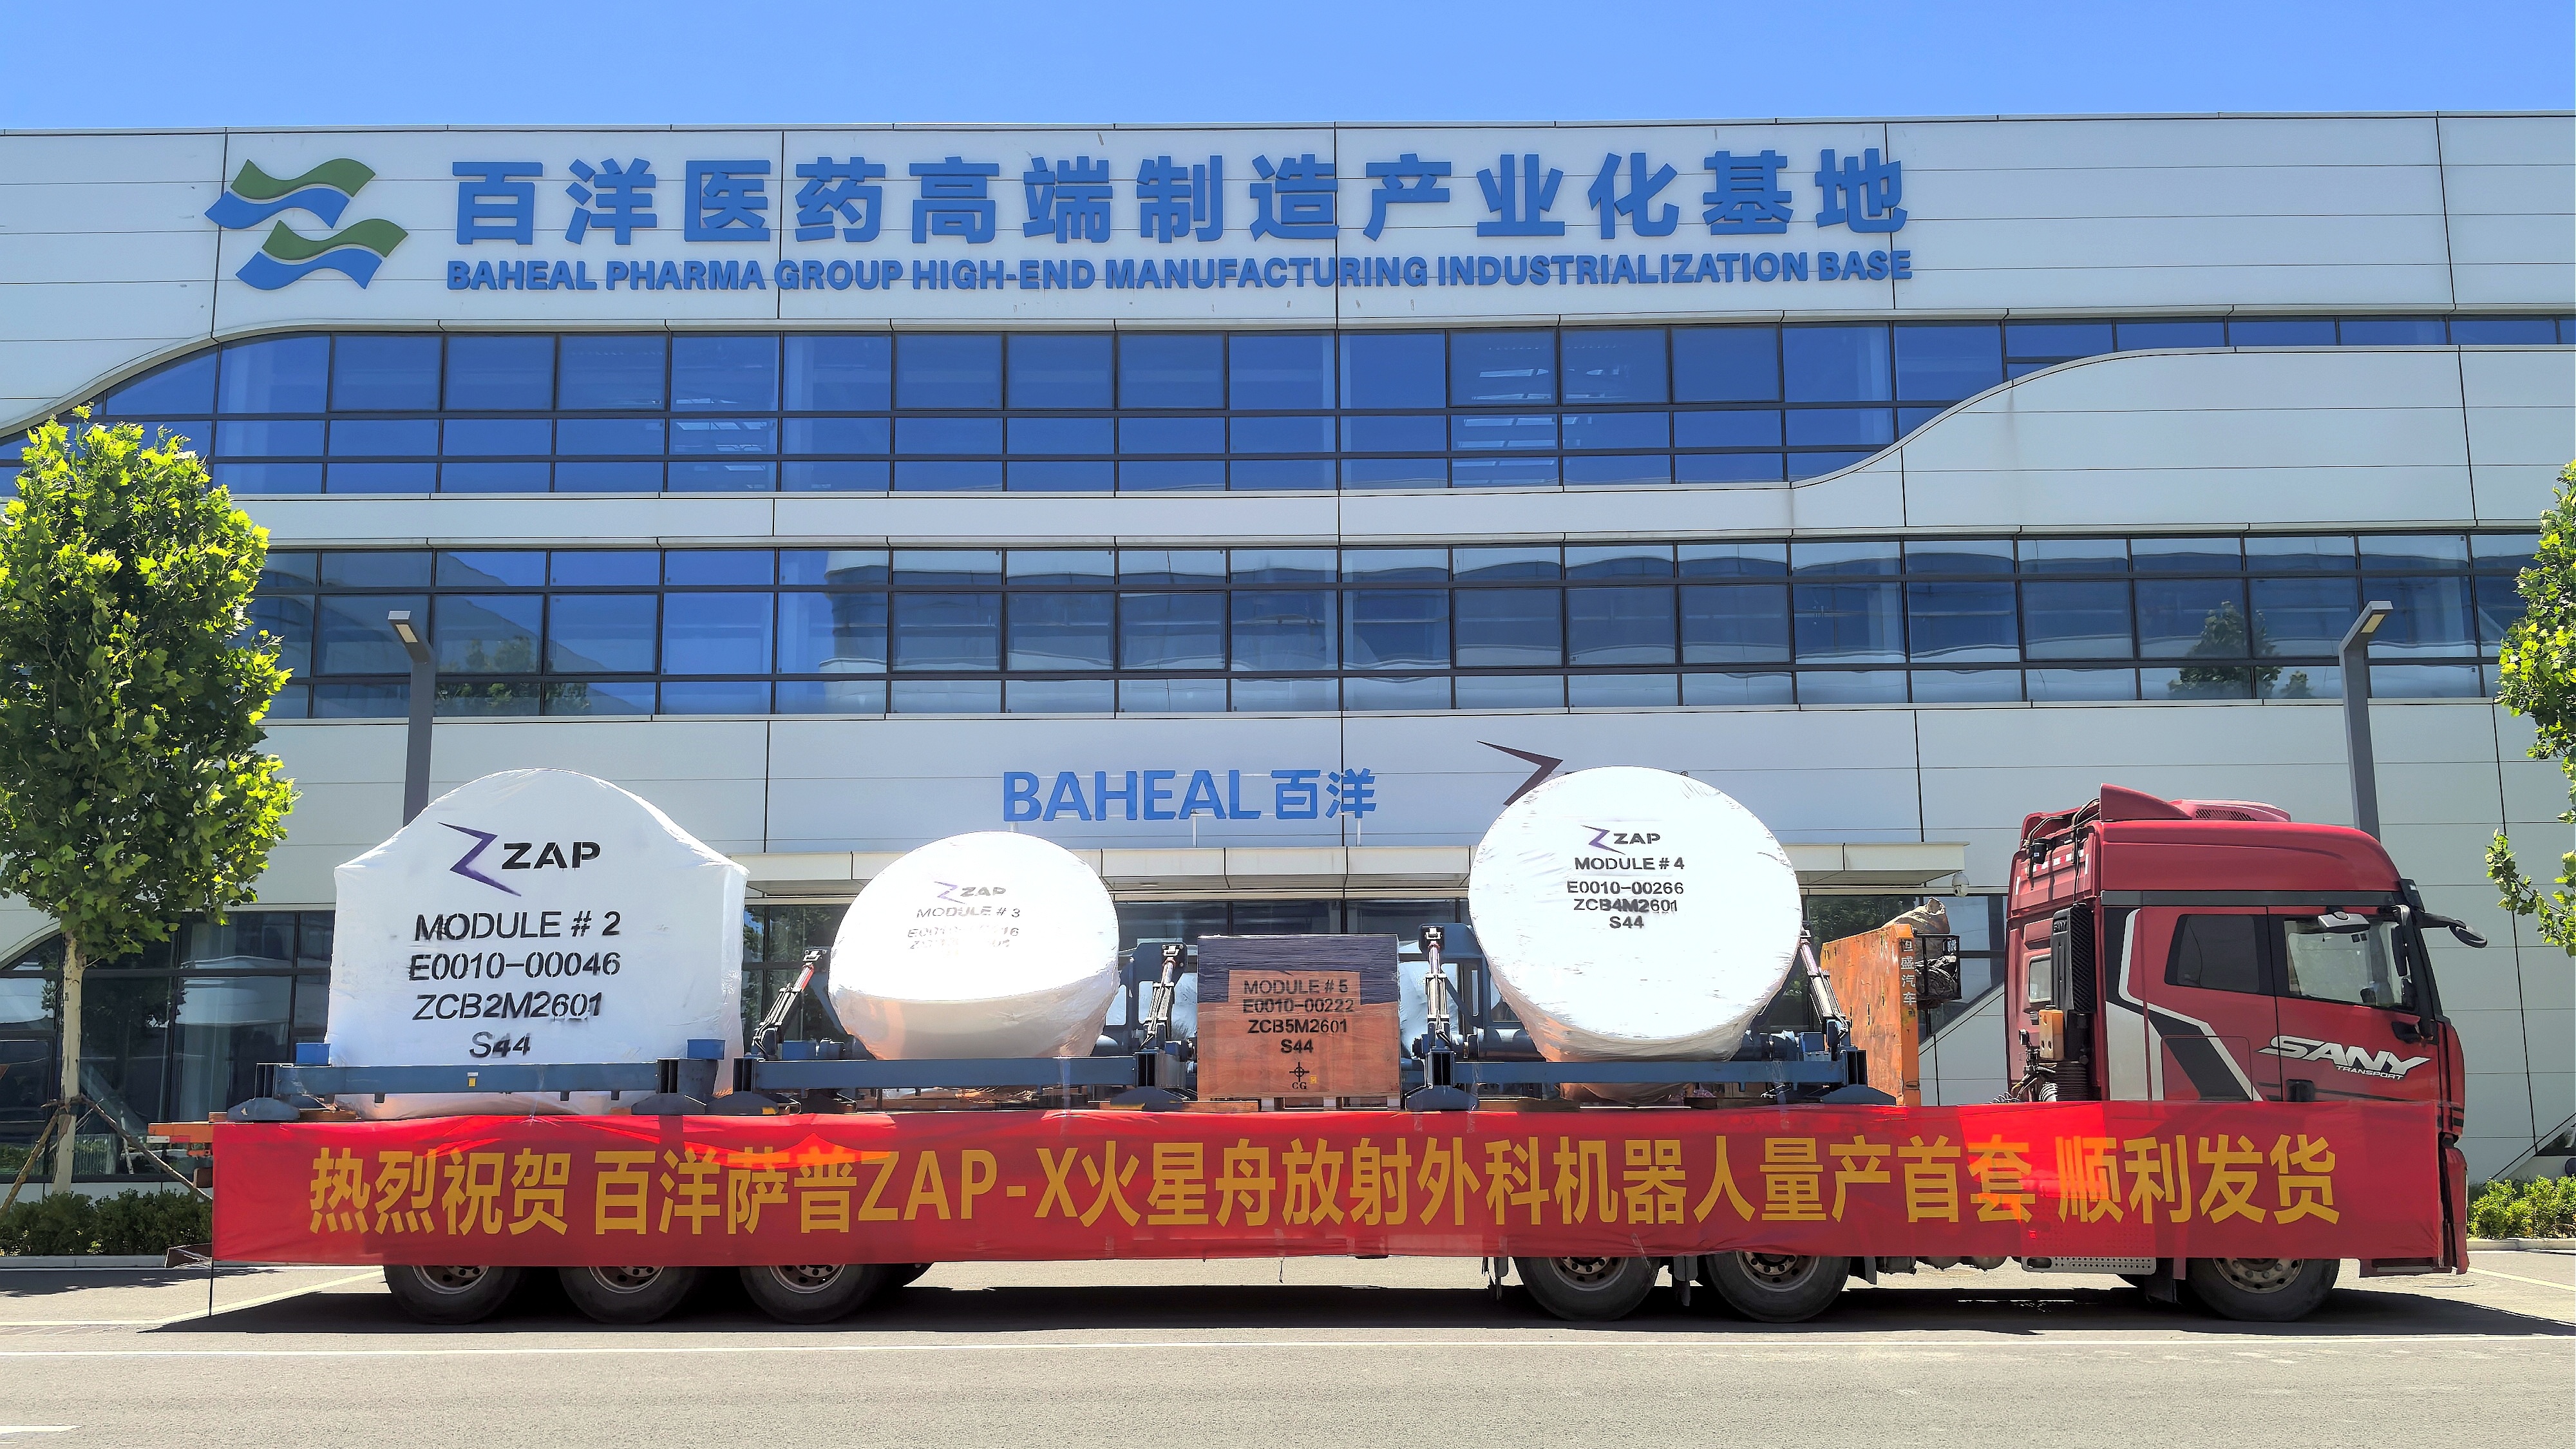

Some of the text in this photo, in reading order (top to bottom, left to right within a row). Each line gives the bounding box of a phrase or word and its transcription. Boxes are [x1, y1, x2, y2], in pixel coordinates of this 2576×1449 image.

[452, 147, 1909, 246] 百洋医药高端制造产业化基地
[447, 249, 1913, 290] BAHEAL PHARMA GROUP HIGH-END MANUFACTURING INDUSTRIALIZATION BASE
[1003, 768, 1378, 822] BAHEAL 百洋
[1613, 833, 1661, 845] ZAP
[502, 842, 601, 871] ZAP
[1575, 857, 1685, 870] MODULE # 4
[960, 886, 1007, 897] ZAP
[1567, 880, 1684, 895] E0010-00266
[916, 905, 1021, 918] MODULE # 3
[1573, 898, 1678, 912] ZCB4M2601
[414, 910, 621, 942] MODULE # 2
[1609, 915, 1645, 929] S44
[408, 951, 621, 981] E0010-00046
[1244, 979, 1349, 994] MODULE # 5
[412, 990, 602, 1021] ZCB2M2601
[1242, 998, 1354, 1013] E0010-00222
[1247, 1018, 1347, 1034] ZCB5M2601
[469, 1031, 531, 1058] S44
[1280, 1038, 1314, 1054] S44
[2257, 1035, 2432, 1075] SANY
[2336, 1065, 2404, 1081] TRANSPORT
[1292, 1082, 1307, 1090] CG
[310, 1133, 2340, 1235] 热烈祝贺 百洋萨普ZAP-X火星舟放射外科机器人量产首套 顺利发货
